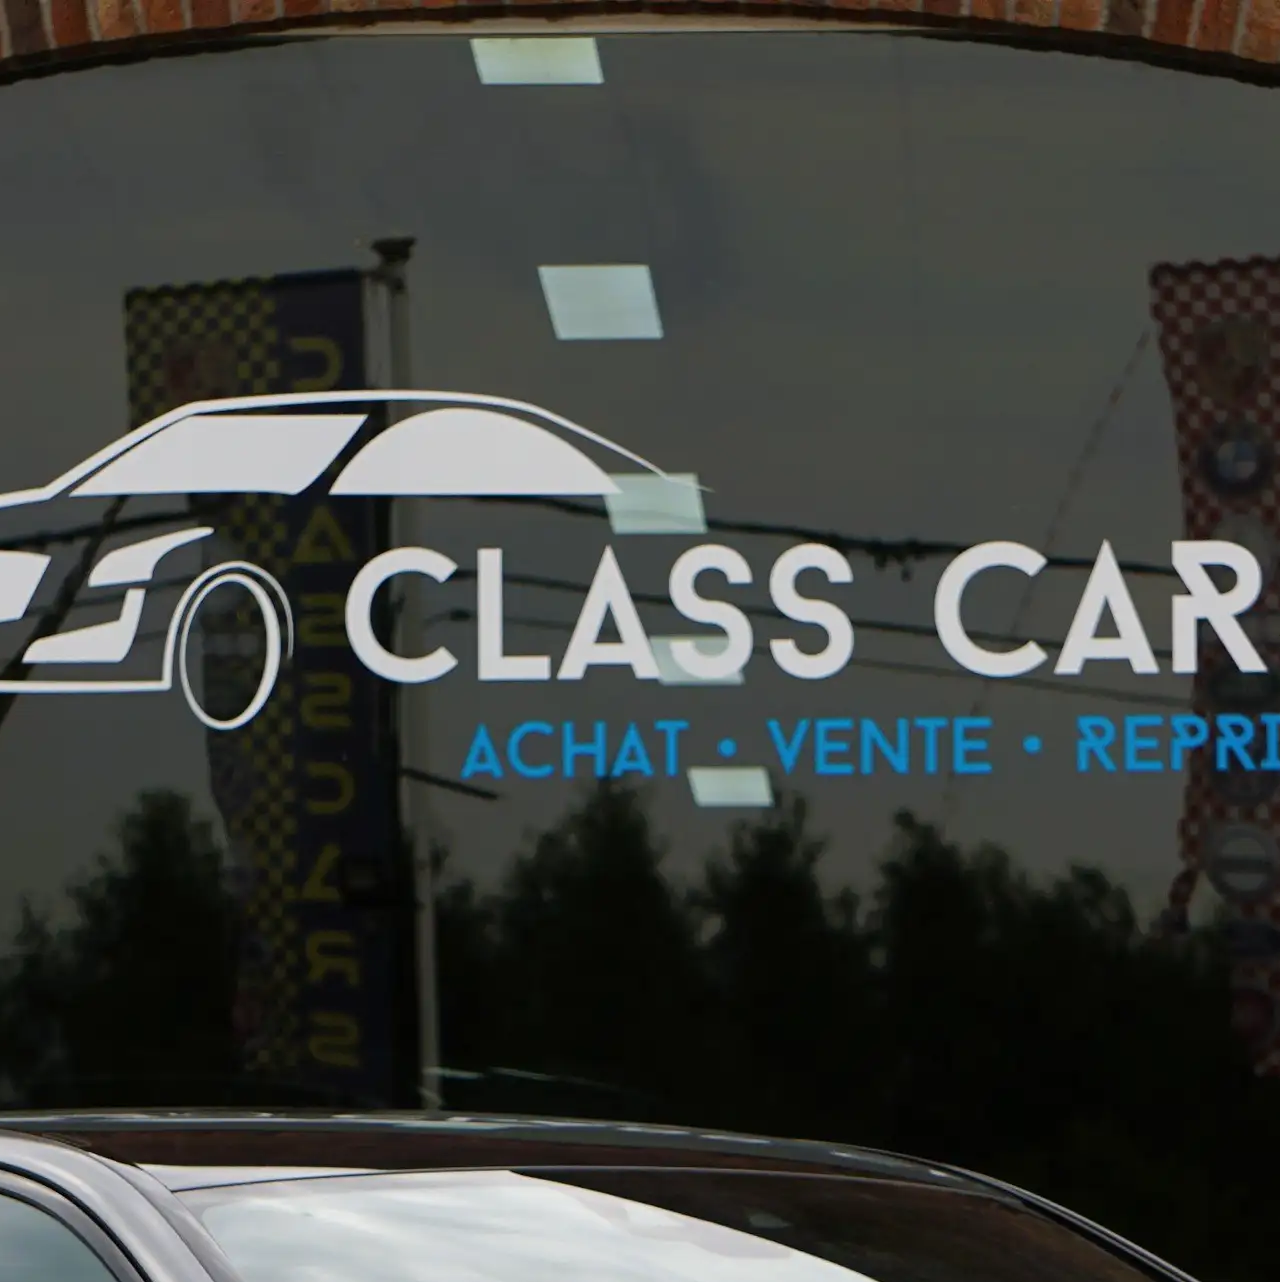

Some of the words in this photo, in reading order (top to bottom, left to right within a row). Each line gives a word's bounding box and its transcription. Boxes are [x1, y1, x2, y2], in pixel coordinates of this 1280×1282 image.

[345, 543, 854, 683] CLASS
[461, 720, 690, 779] ACHAT
[766, 717, 992, 775] VENTE
